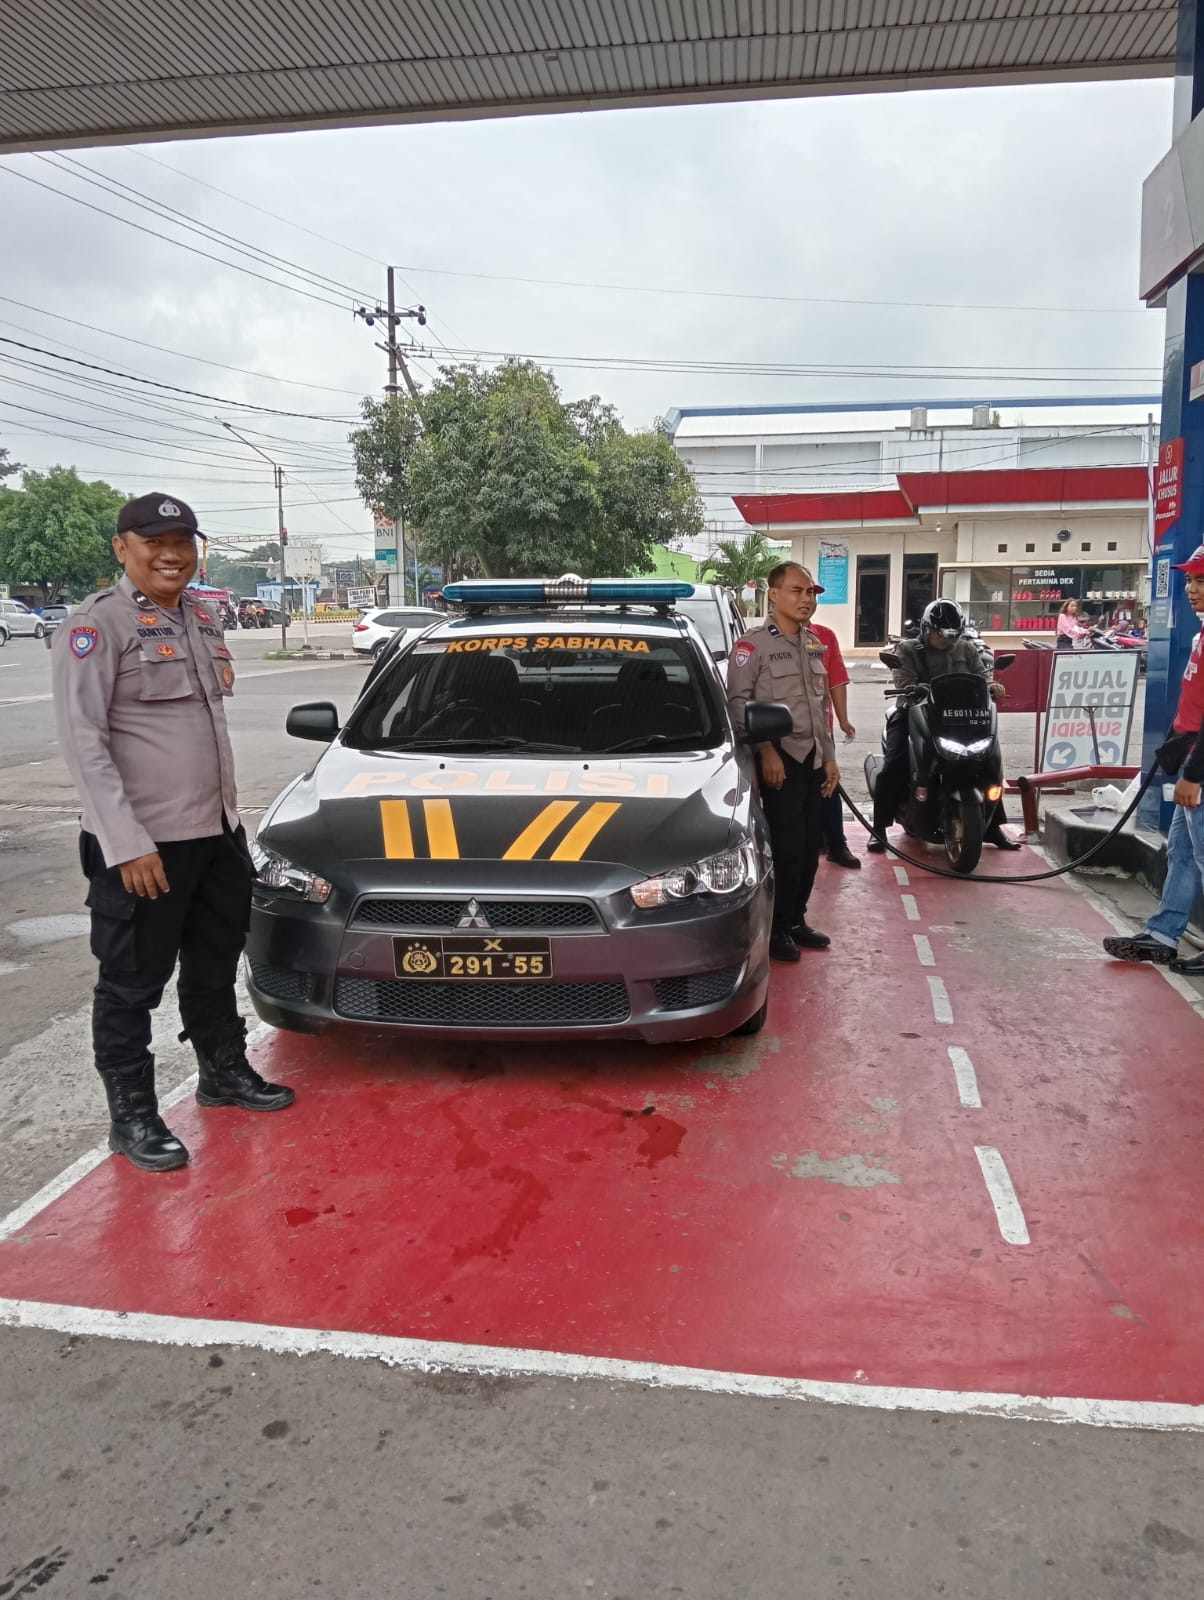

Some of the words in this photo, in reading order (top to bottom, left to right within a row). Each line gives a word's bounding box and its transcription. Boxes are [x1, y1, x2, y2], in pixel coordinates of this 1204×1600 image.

[1158, 466, 1178, 486] JALUR
[1157, 485, 1177, 500] KHUSUS
[376, 529, 393, 537] BNI
[1034, 569, 1055, 577] SEDIA
[1059, 577, 1074, 585] DEX
[137, 627, 176, 638] GUNTUR
[446, 637, 528, 654] KORPS
[534, 636, 650, 654] SABHARA
[943, 709, 953, 717] AE
[343, 771, 669, 795] POLISI
[483, 938, 503, 951] X
